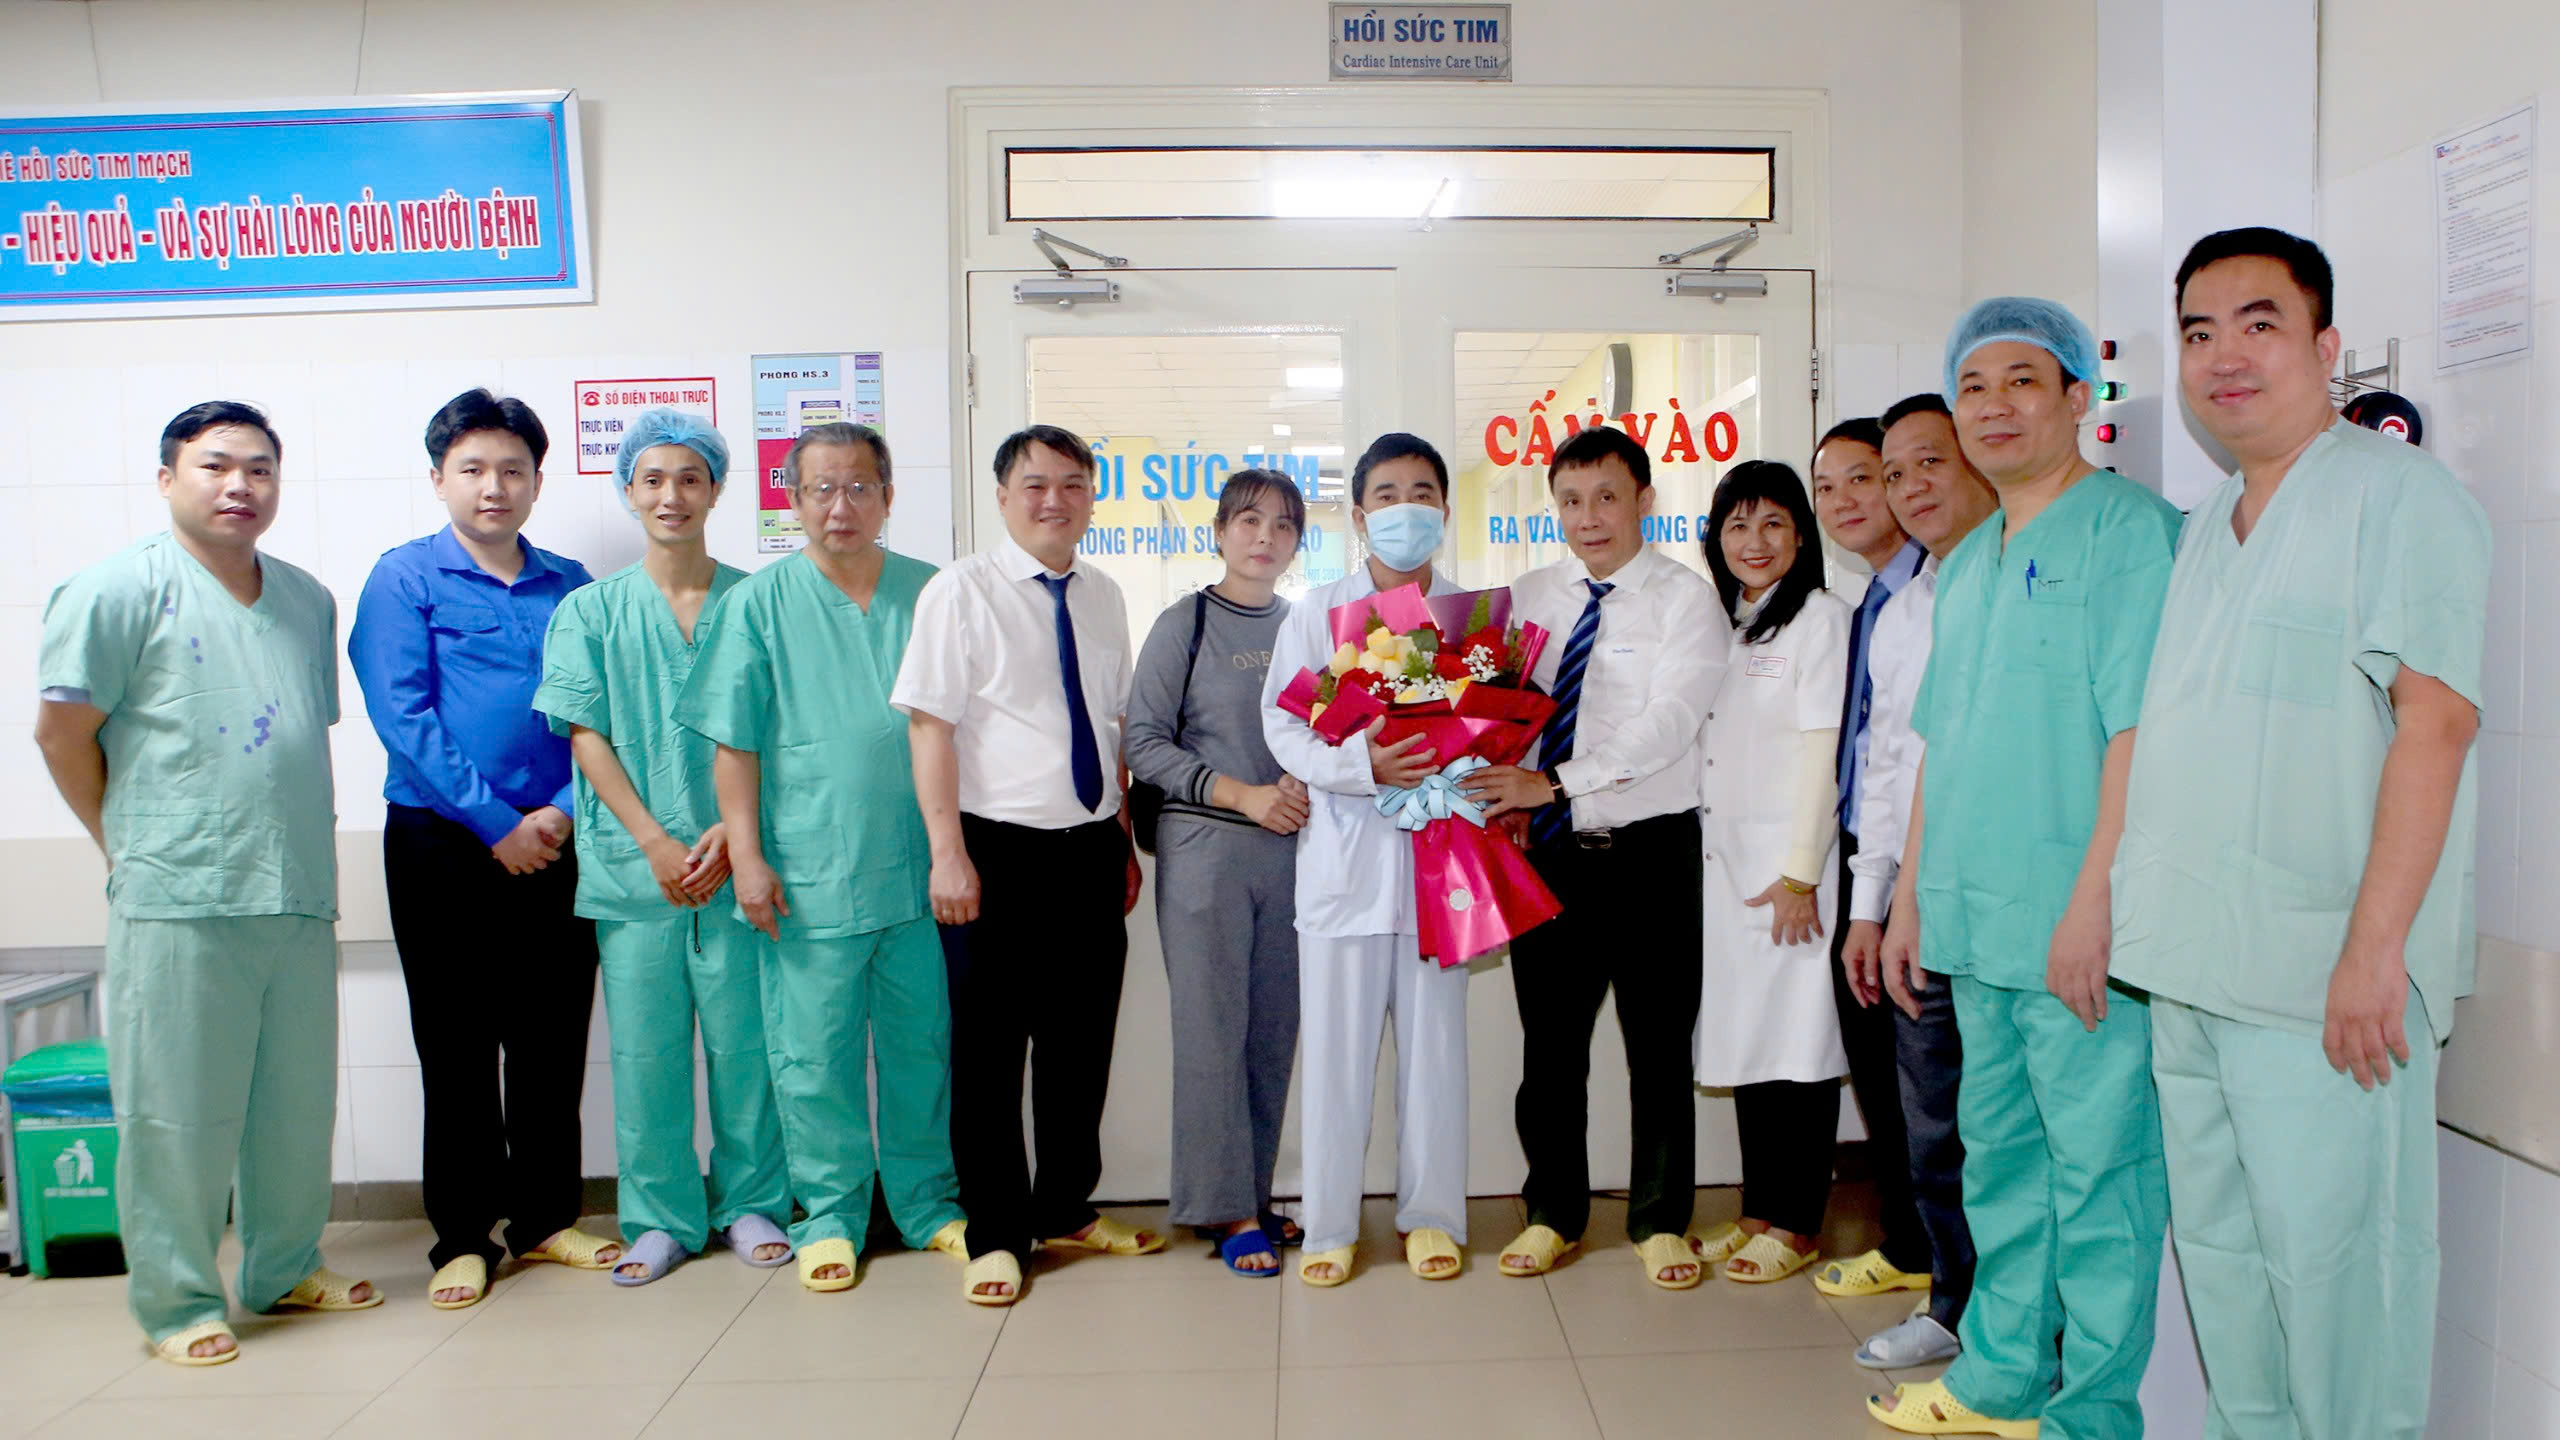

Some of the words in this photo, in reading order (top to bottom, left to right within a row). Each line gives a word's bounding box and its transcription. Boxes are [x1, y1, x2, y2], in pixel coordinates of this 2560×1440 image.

[1343, 10, 1385, 42] HỒI
[1394, 13, 1445, 43] SỨC
[1453, 20, 1498, 43] TIM
[1343, 55, 1386, 68] Cardiac
[1389, 55, 1441, 68] Intensive
[1446, 56, 1471, 69] Care
[1475, 55, 1499, 69] Unit
[97, 154, 131, 179] TIM
[137, 152, 191, 183] MẠCH
[25, 204, 82, 275] HIỆU
[86, 196, 135, 267] QUẢ
[158, 199, 193, 260] VÀ
[198, 204, 229, 269] SỰ
[233, 197, 277, 257] HÀI
[281, 195, 342, 255] LÒNG
[349, 188, 396, 255] CỦA
[400, 190, 473, 251] NGƯỜI
[477, 188, 541, 258] BỆNH
[802, 370, 829, 378] HS.3
[622, 389, 647, 407] ĐIỆN
[650, 390, 680, 406] THOẠI
[682, 389, 709, 405] TRỰC
[1618, 398, 1739, 463] VÀO
[1141, 441, 1229, 502] SỨC
[763, 519, 776, 527] WC
[1489, 516, 1520, 544] RA
